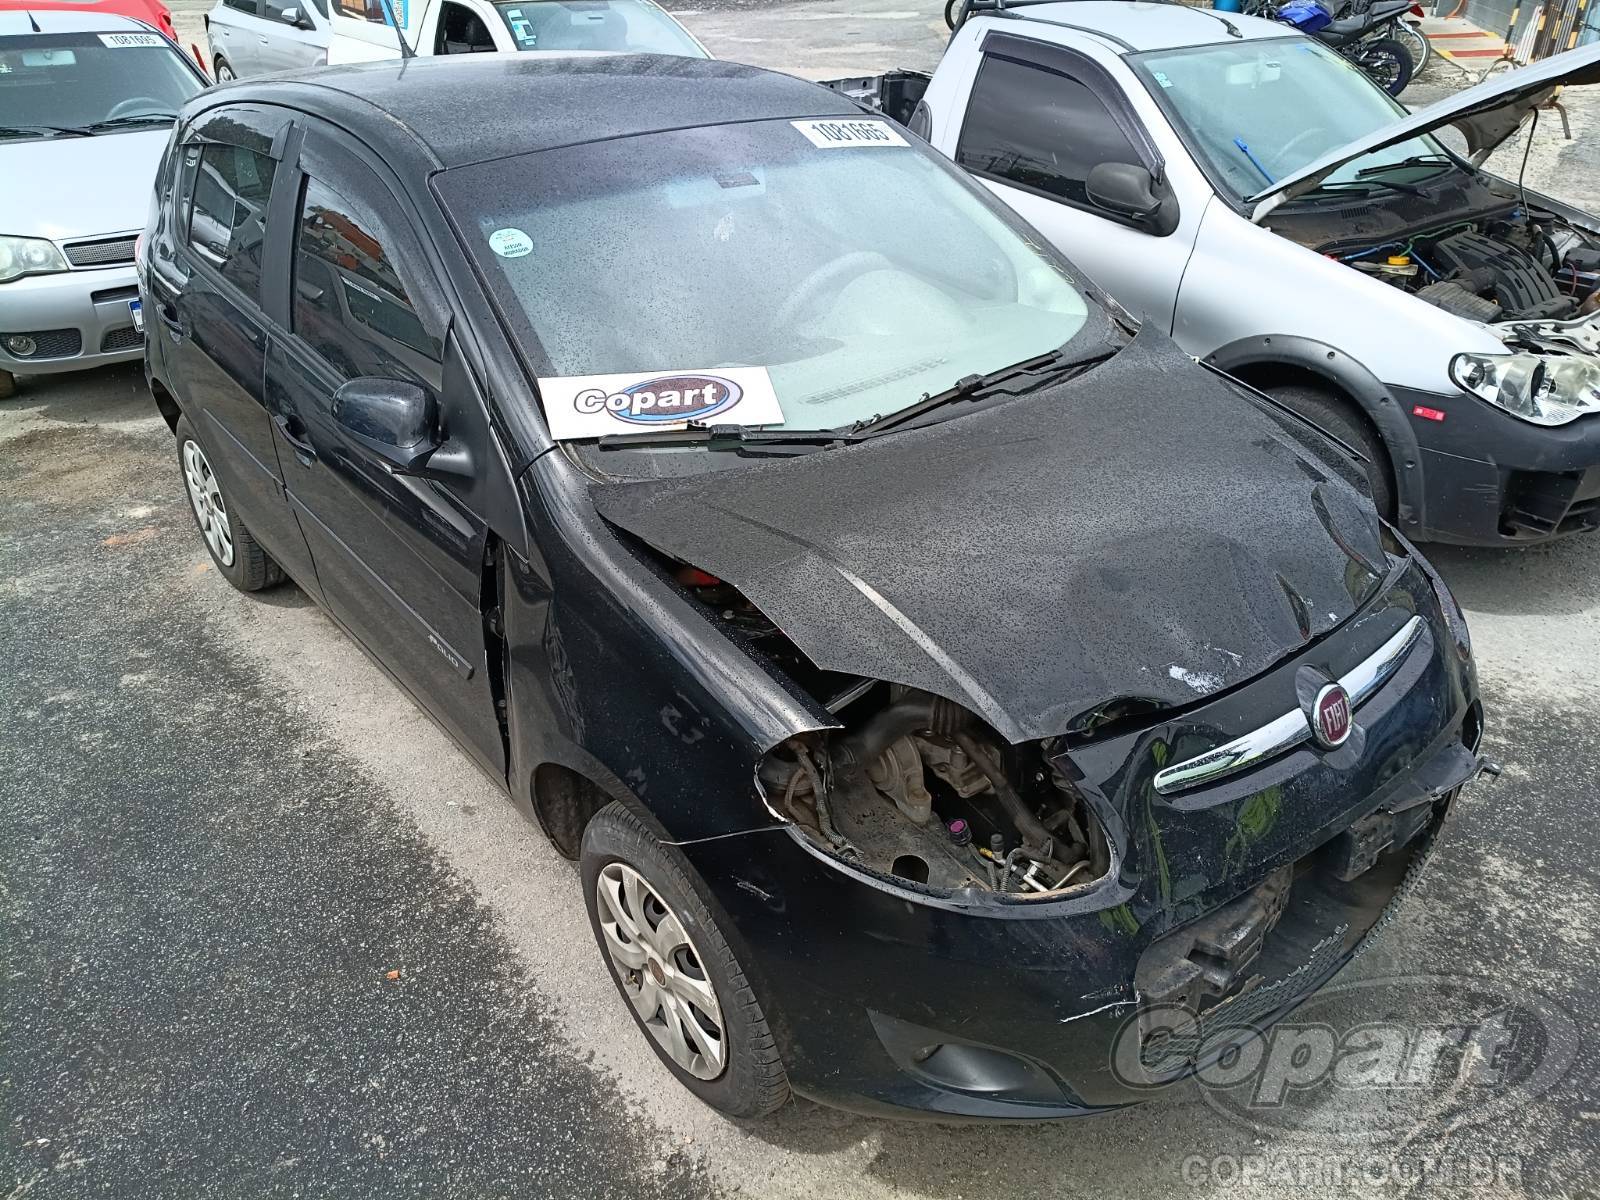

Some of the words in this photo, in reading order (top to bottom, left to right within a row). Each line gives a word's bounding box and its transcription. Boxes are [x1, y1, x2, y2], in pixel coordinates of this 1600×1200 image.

[811, 122, 890, 141] 1081665
[574, 383, 718, 416] Copart
[1323, 697, 1347, 735] FIAT
